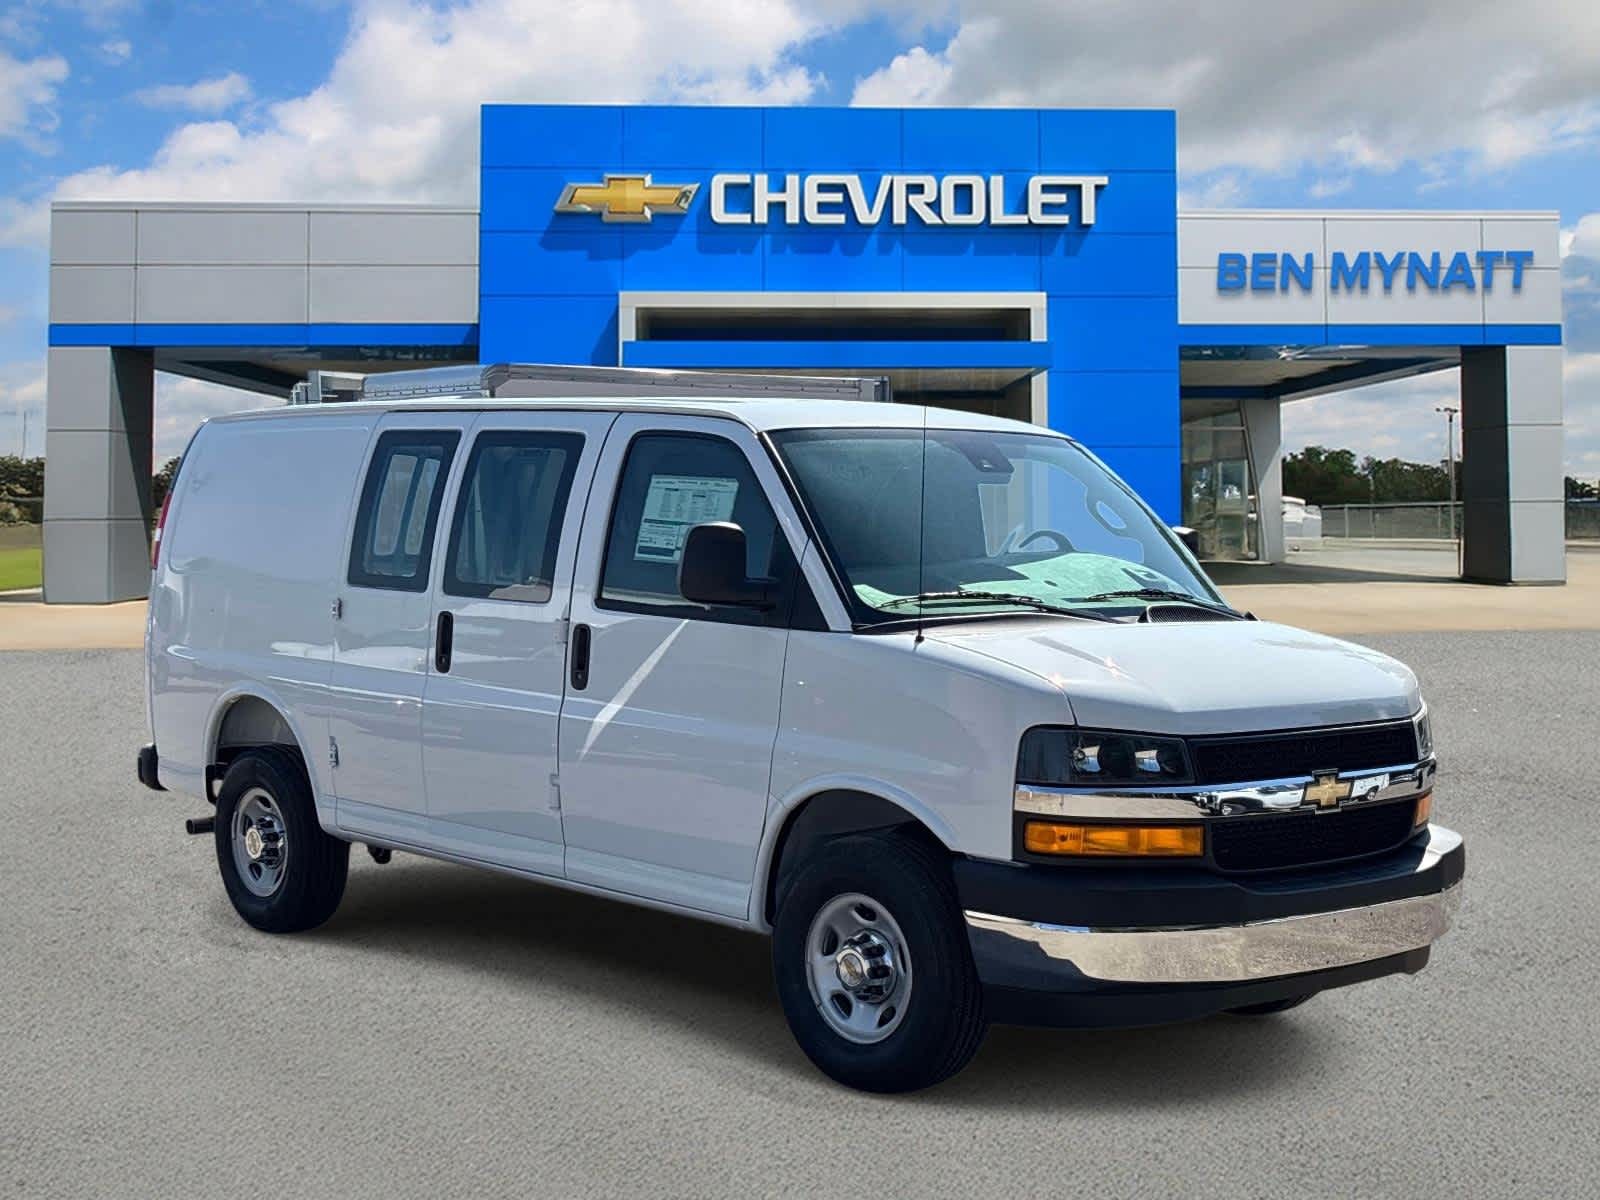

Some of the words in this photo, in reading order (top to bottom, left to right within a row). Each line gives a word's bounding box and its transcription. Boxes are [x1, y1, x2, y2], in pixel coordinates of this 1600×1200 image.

[710, 173, 1109, 225] CHEVROLET
[1216, 252, 1313, 291] BEN
[1330, 251, 1534, 290] MYNATT
